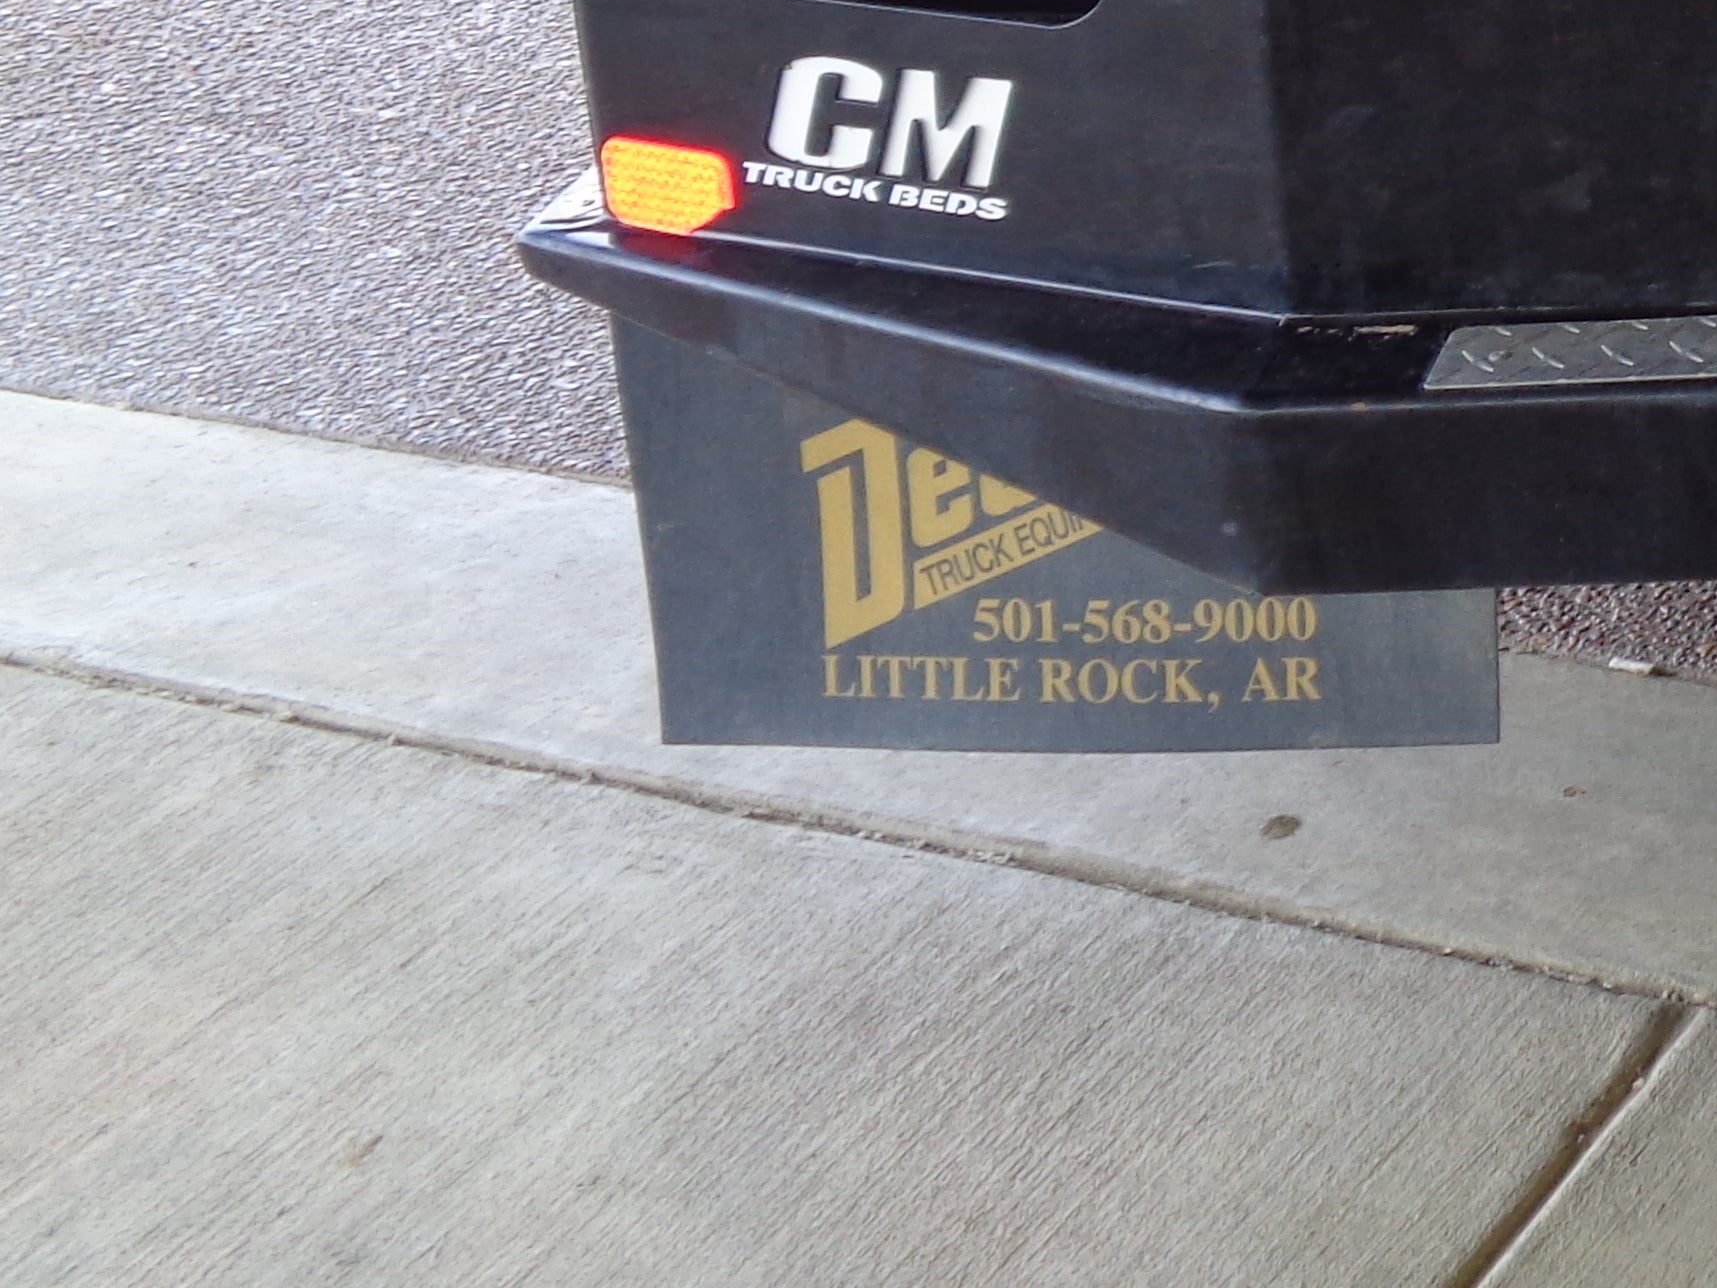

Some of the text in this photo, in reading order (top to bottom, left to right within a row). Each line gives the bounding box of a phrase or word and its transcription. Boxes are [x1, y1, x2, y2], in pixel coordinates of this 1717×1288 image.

[766, 54, 1013, 190] CM
[742, 160, 1008, 221] TRUCK BEDS
[919, 531, 1014, 596] TRUCK
[973, 597, 1317, 645] 501-568-9000
[823, 655, 1322, 713] LITTLE ROCK, AR
